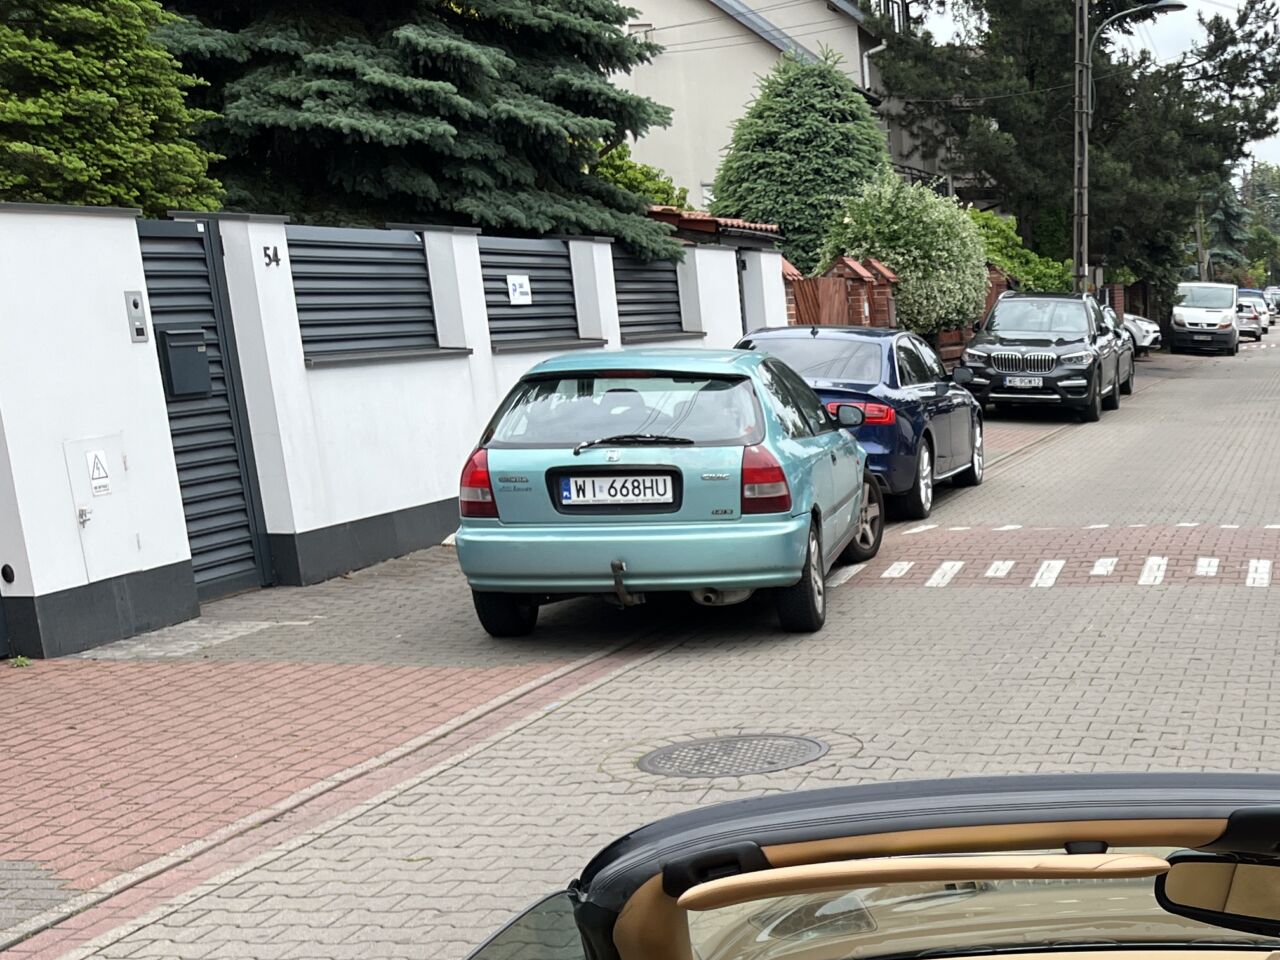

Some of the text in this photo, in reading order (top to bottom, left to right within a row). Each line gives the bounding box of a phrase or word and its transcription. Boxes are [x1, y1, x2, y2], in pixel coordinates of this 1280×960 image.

[263, 246, 281, 267] 54
[575, 479, 596, 498] WI
[608, 478, 667, 498] 668HU
